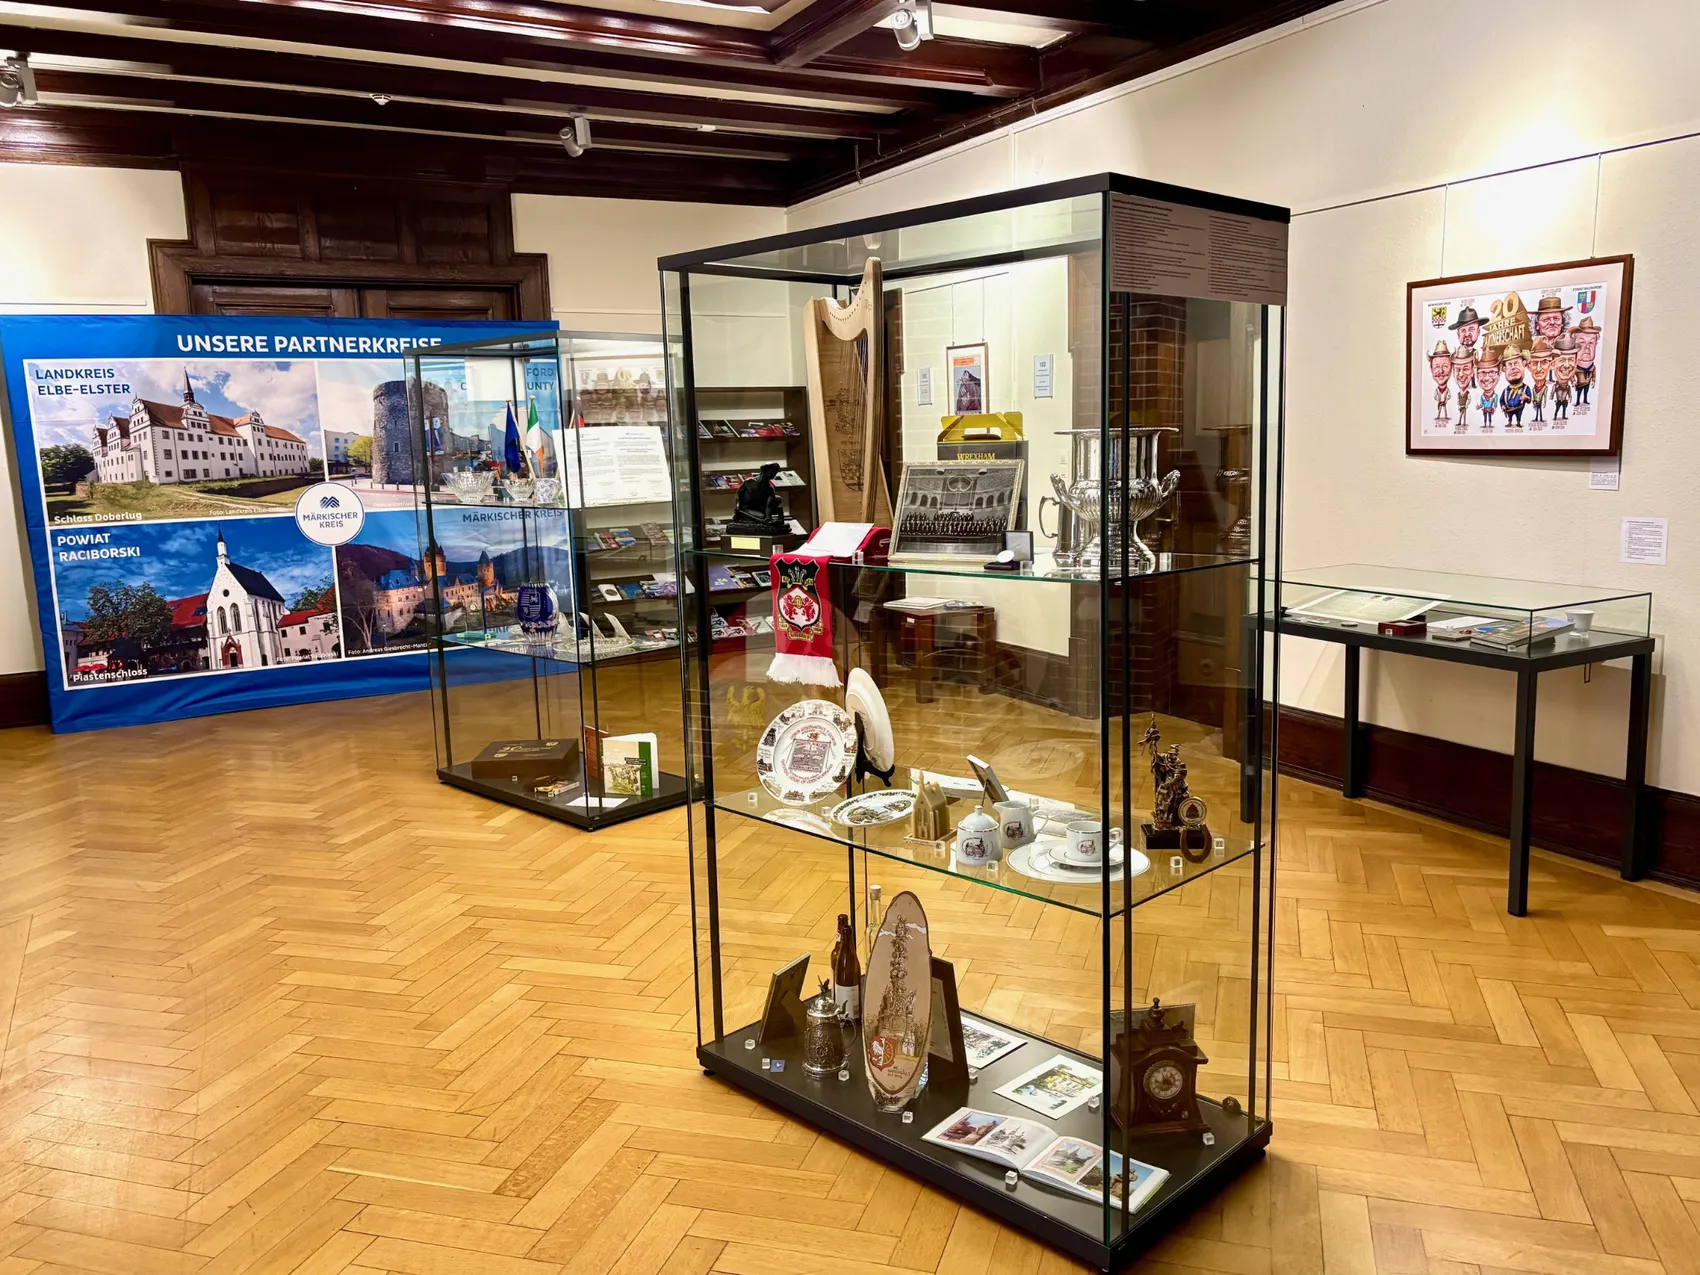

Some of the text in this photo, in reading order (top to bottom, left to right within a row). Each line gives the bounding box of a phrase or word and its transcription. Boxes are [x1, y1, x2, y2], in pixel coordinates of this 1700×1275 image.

[177, 335, 269, 352] UNSERE
[35, 368, 115, 380] LANDKREIS
[37, 384, 131, 396] ELBE-ELSTER
[957, 452, 996, 461] WREXHAM
[54, 510, 143, 524] Schloss Doberlug
[302, 511, 358, 521] MÄRKISCHER
[463, 506, 563, 523] MÄRKISCHER KREIS
[319, 520, 344, 529] KREIS
[57, 533, 111, 547] POWIAT
[59, 546, 141, 562] RACIBORSKI
[72, 669, 148, 683] Piastenschloss
